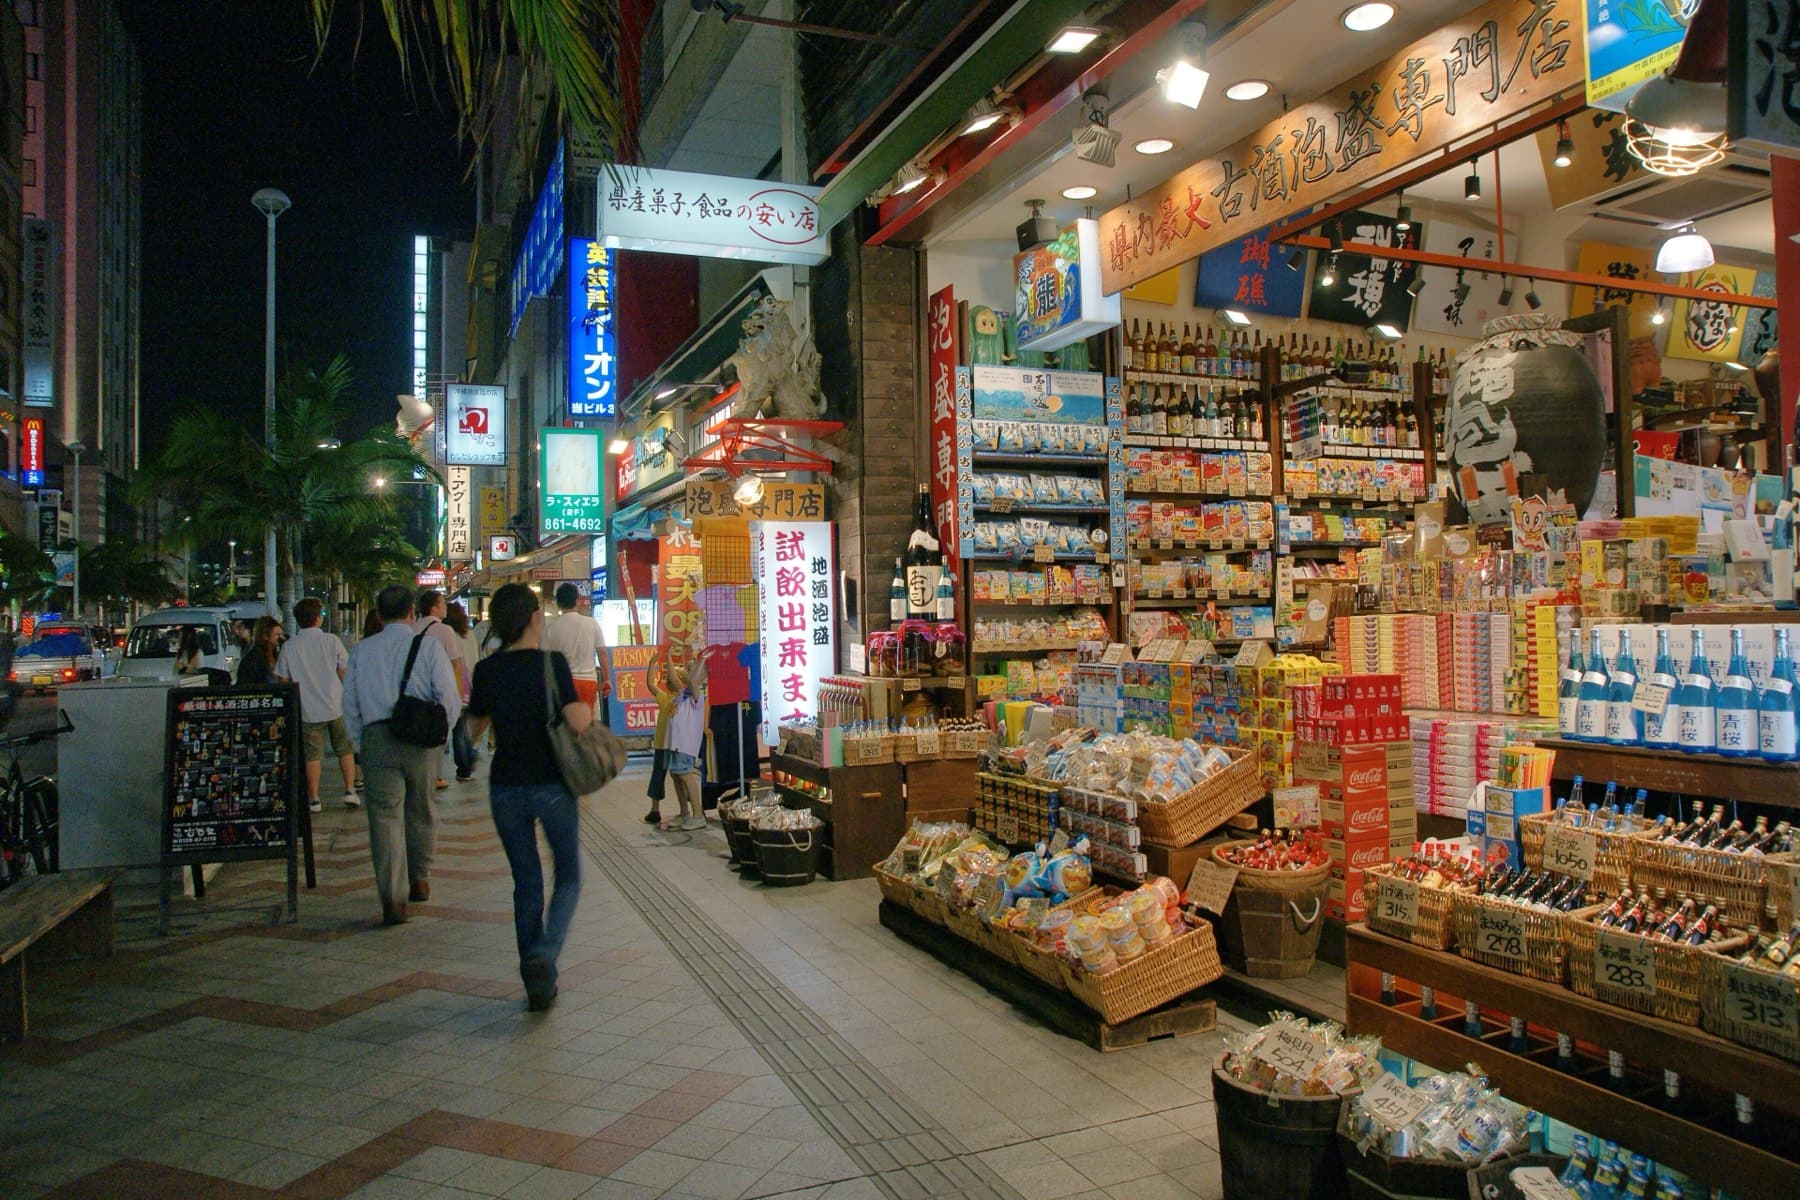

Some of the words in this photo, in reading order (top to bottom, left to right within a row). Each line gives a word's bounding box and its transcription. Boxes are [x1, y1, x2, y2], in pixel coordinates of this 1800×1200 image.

[544, 518, 602, 531] 861-4692
[811, 557, 830, 646] 地酒泡盛
[1680, 711, 1697, 742] 青桜
[1721, 714, 1741, 746] 青桜
